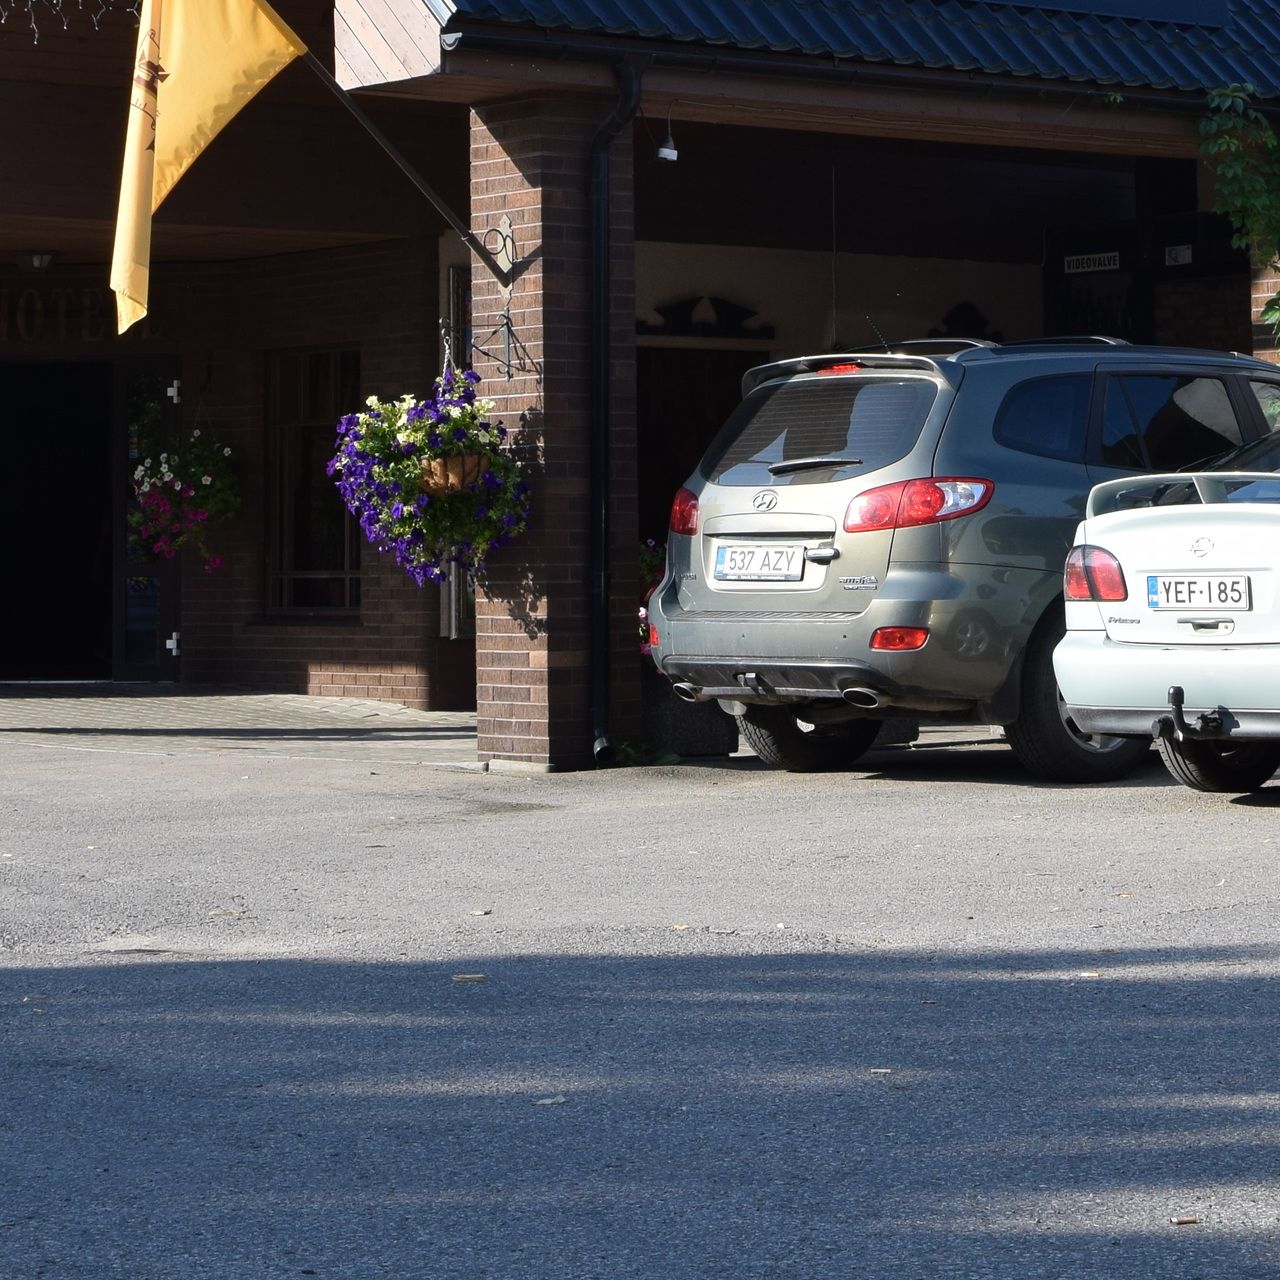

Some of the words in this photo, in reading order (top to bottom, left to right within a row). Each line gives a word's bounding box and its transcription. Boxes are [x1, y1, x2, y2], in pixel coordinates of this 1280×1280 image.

[1066, 255, 1118, 270] VIDEOVALVE
[729, 551, 755, 571] 537
[760, 550, 795, 571] AZY
